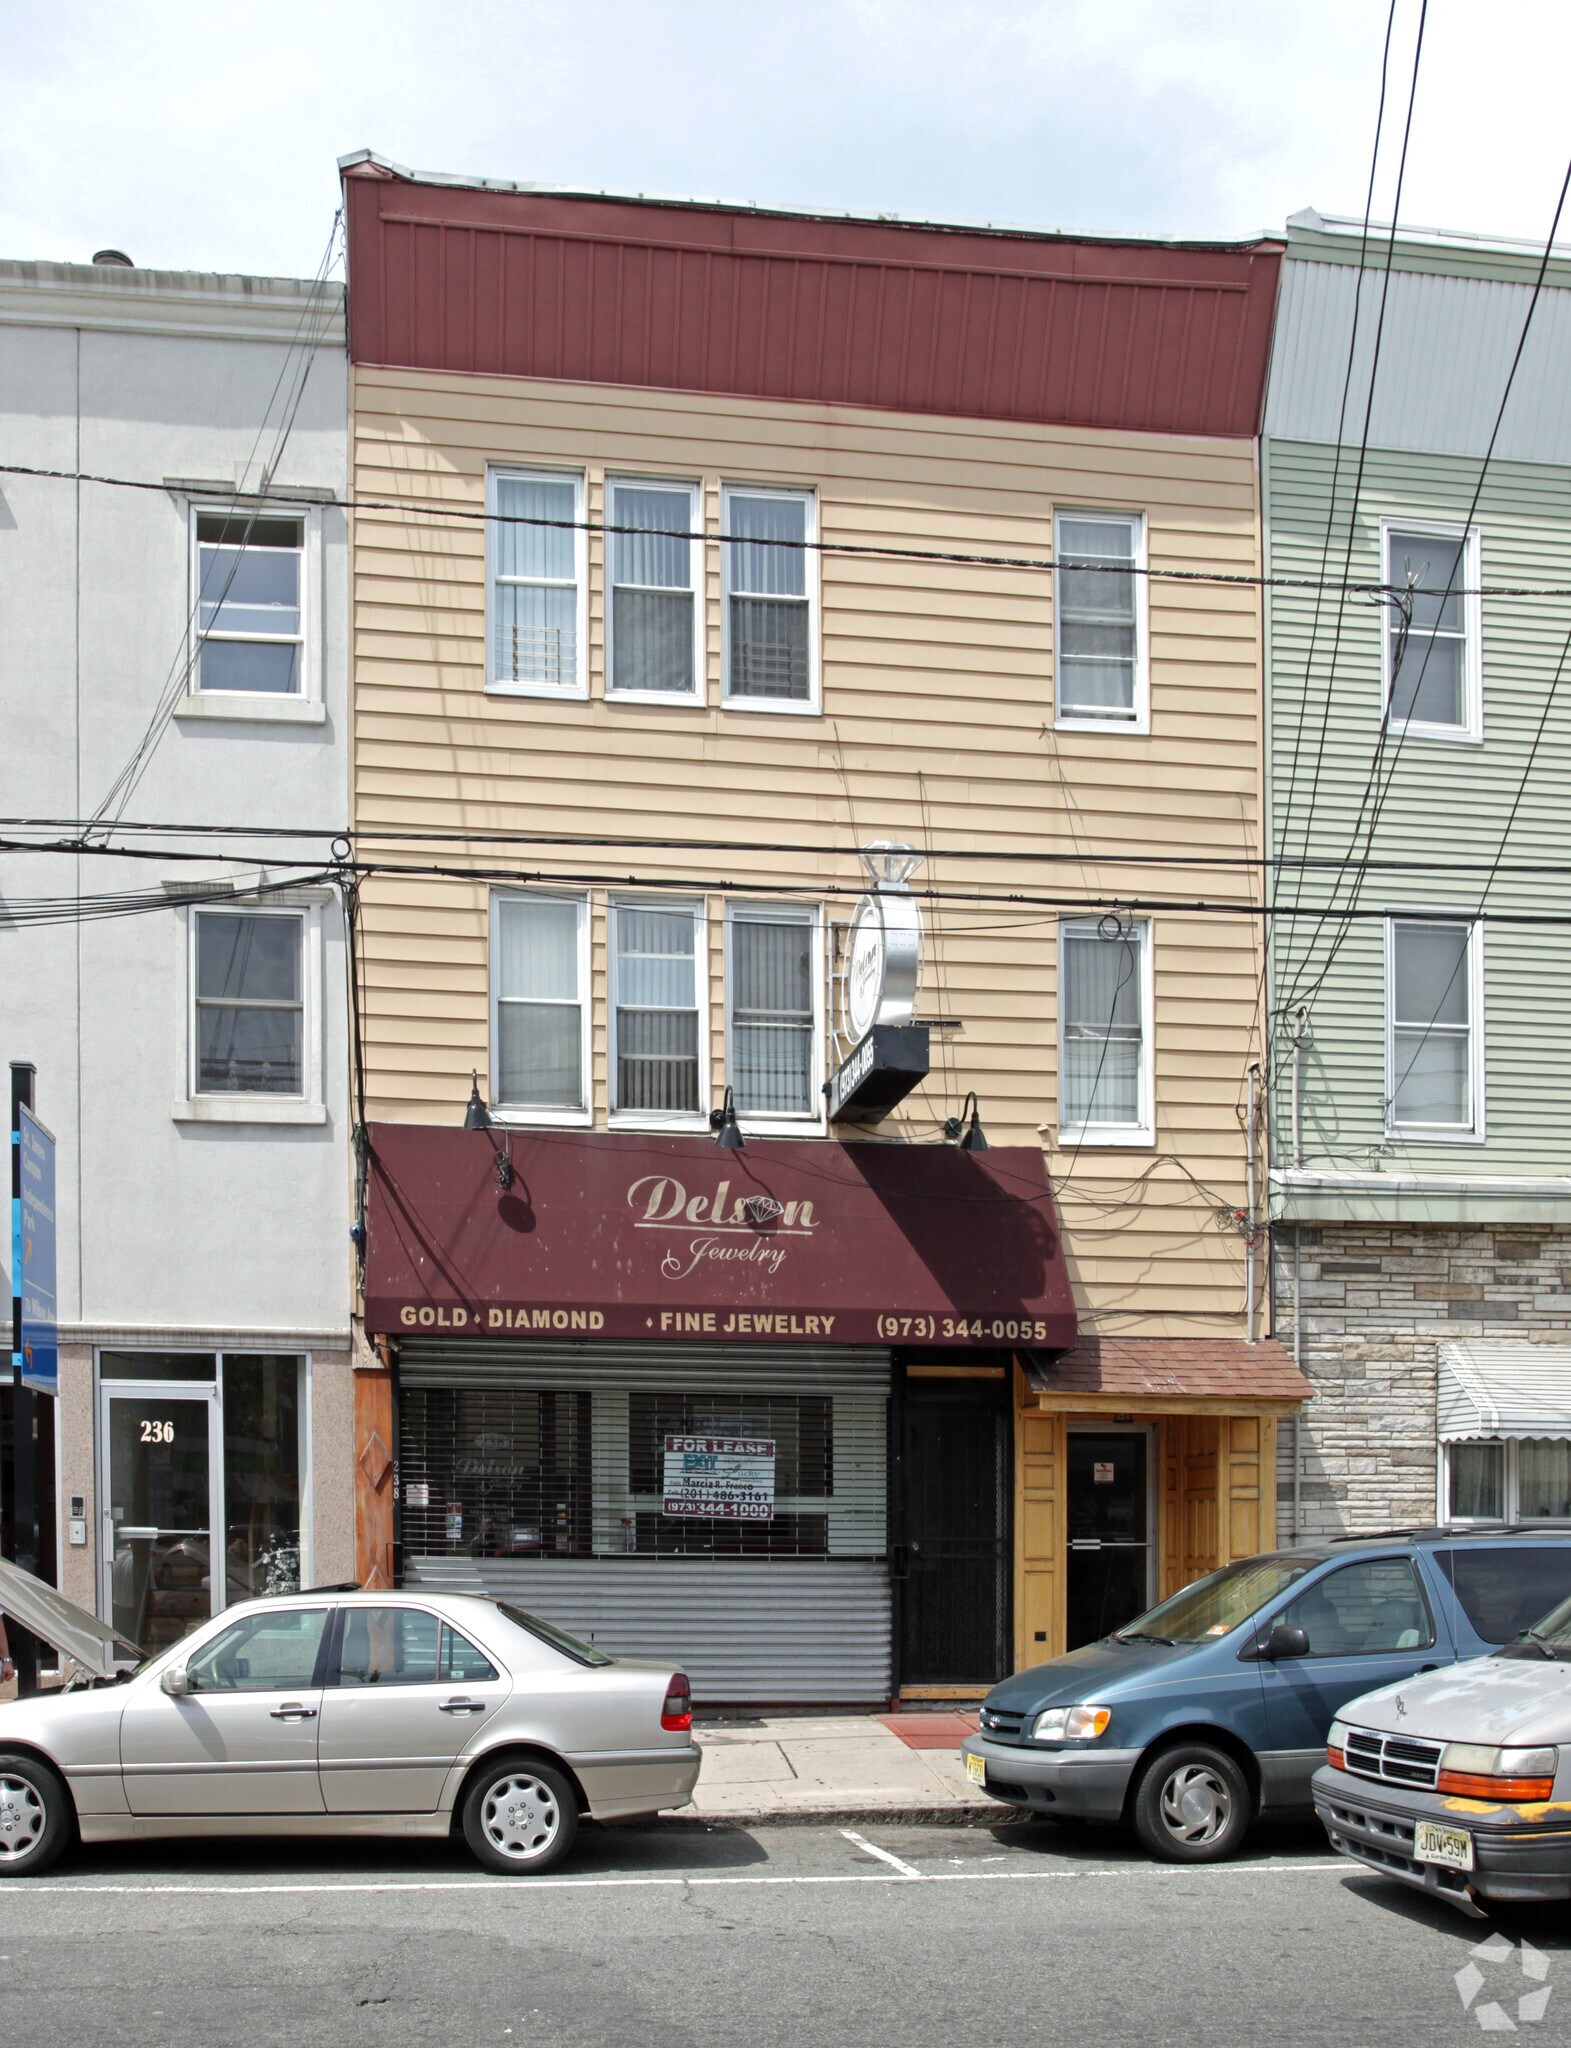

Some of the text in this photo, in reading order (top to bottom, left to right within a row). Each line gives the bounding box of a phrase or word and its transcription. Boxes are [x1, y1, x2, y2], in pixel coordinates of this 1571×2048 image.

[661, 1237, 786, 1279] Jewelry
[400, 1306, 1047, 1340] GOLD DIAMOND FINE JEWELRY (973) 344-0055
[140, 1420, 174, 1443] 236
[673, 1438, 767, 1455] FOR LEASE
[683, 1477, 713, 1489] Marcia
